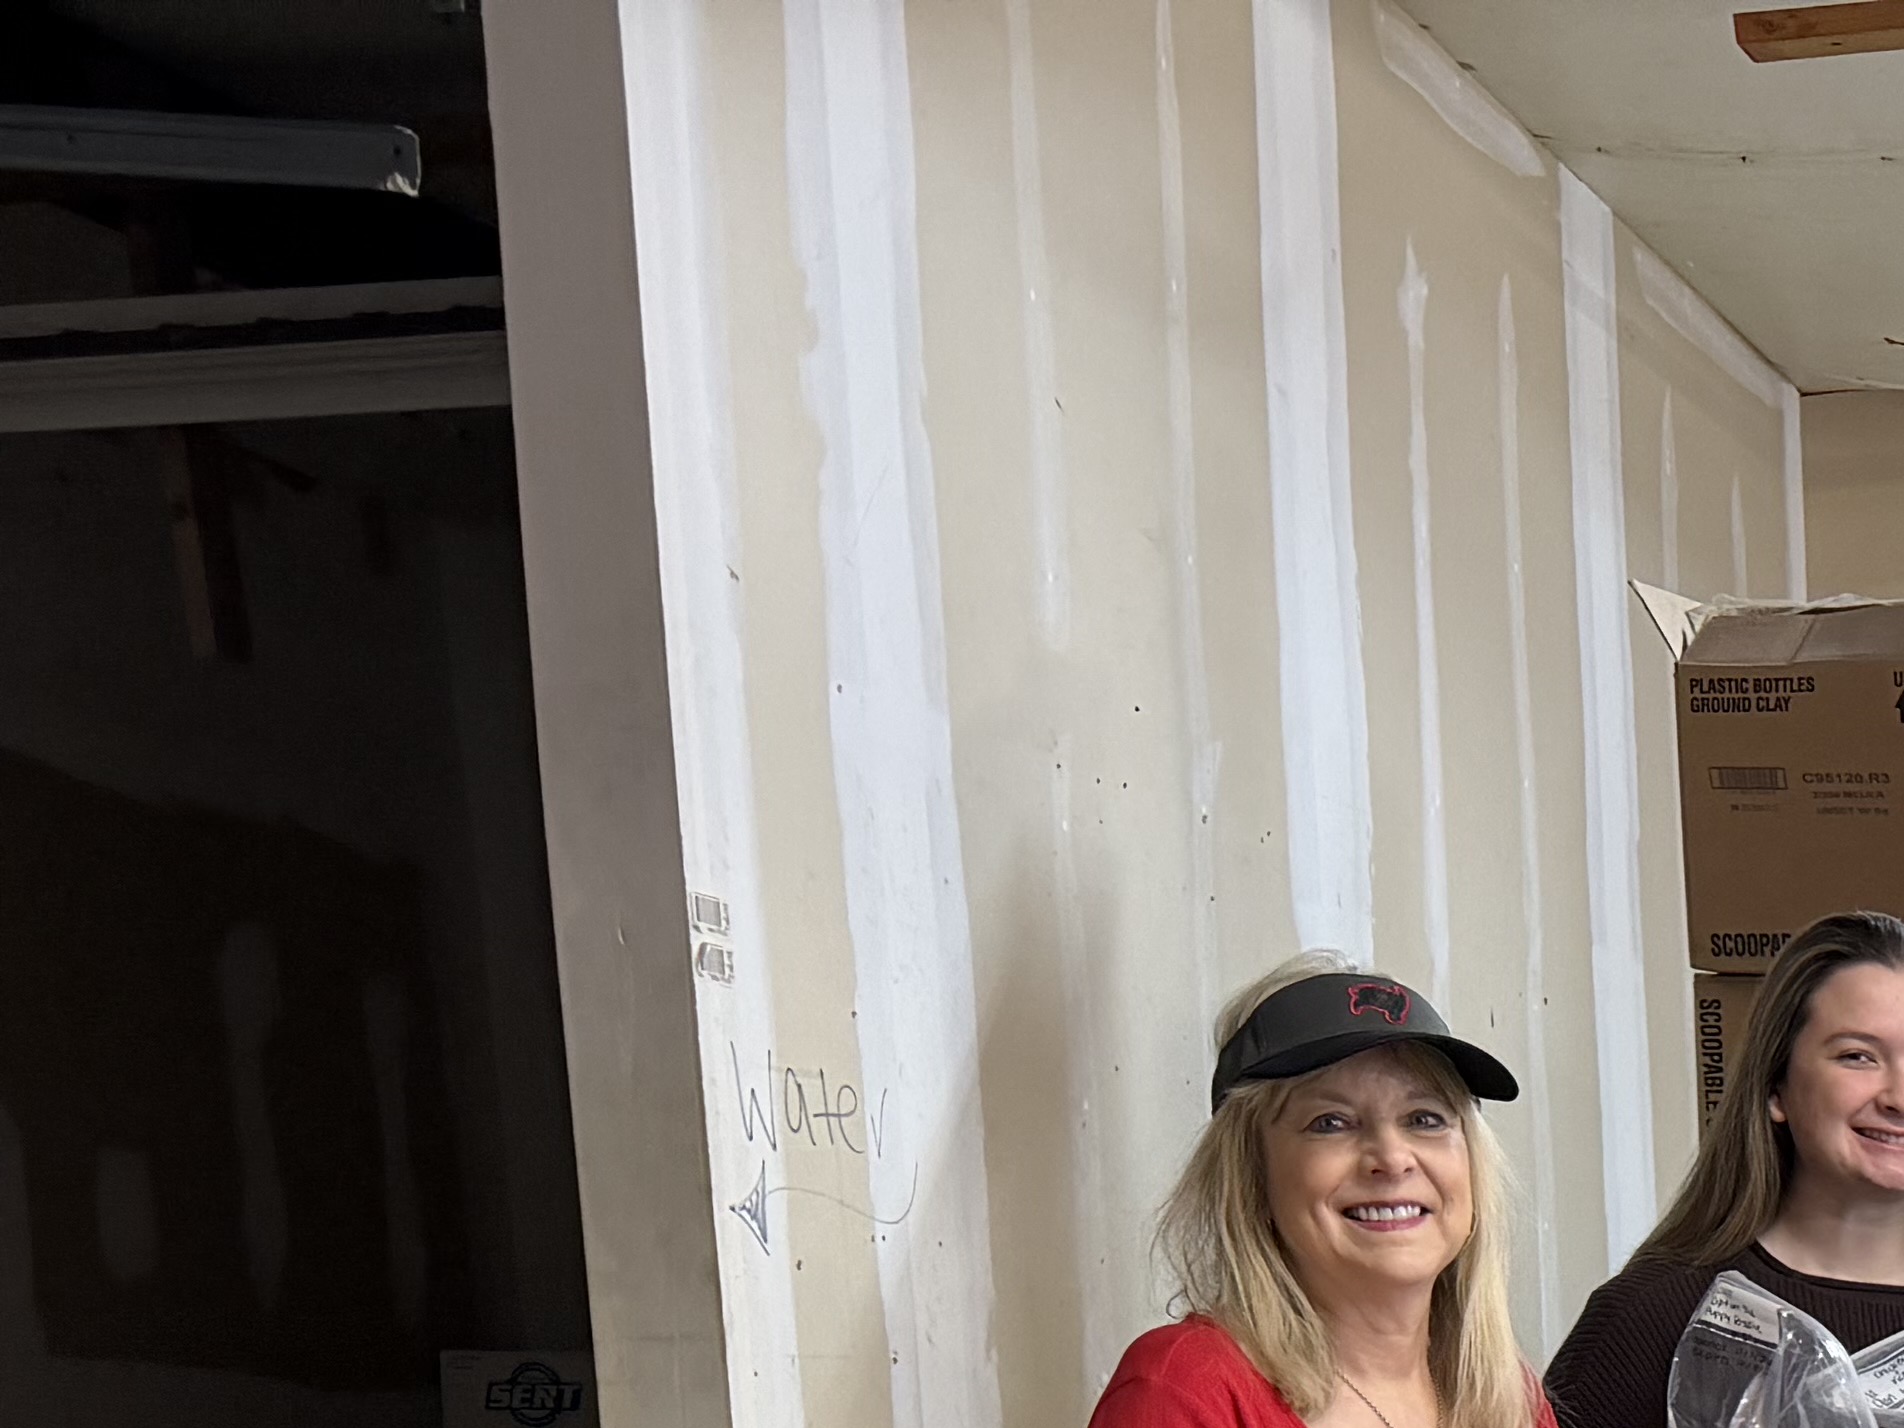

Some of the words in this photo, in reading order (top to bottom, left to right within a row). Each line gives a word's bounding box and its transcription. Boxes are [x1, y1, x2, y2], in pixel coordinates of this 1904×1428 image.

[1690, 677, 1749, 695] PLASTIC
[1753, 676, 1815, 694] BOTTLES
[1690, 696, 1751, 713] GROUND
[1756, 696, 1792, 712] CLAY
[730, 1041, 887, 1159] Water
